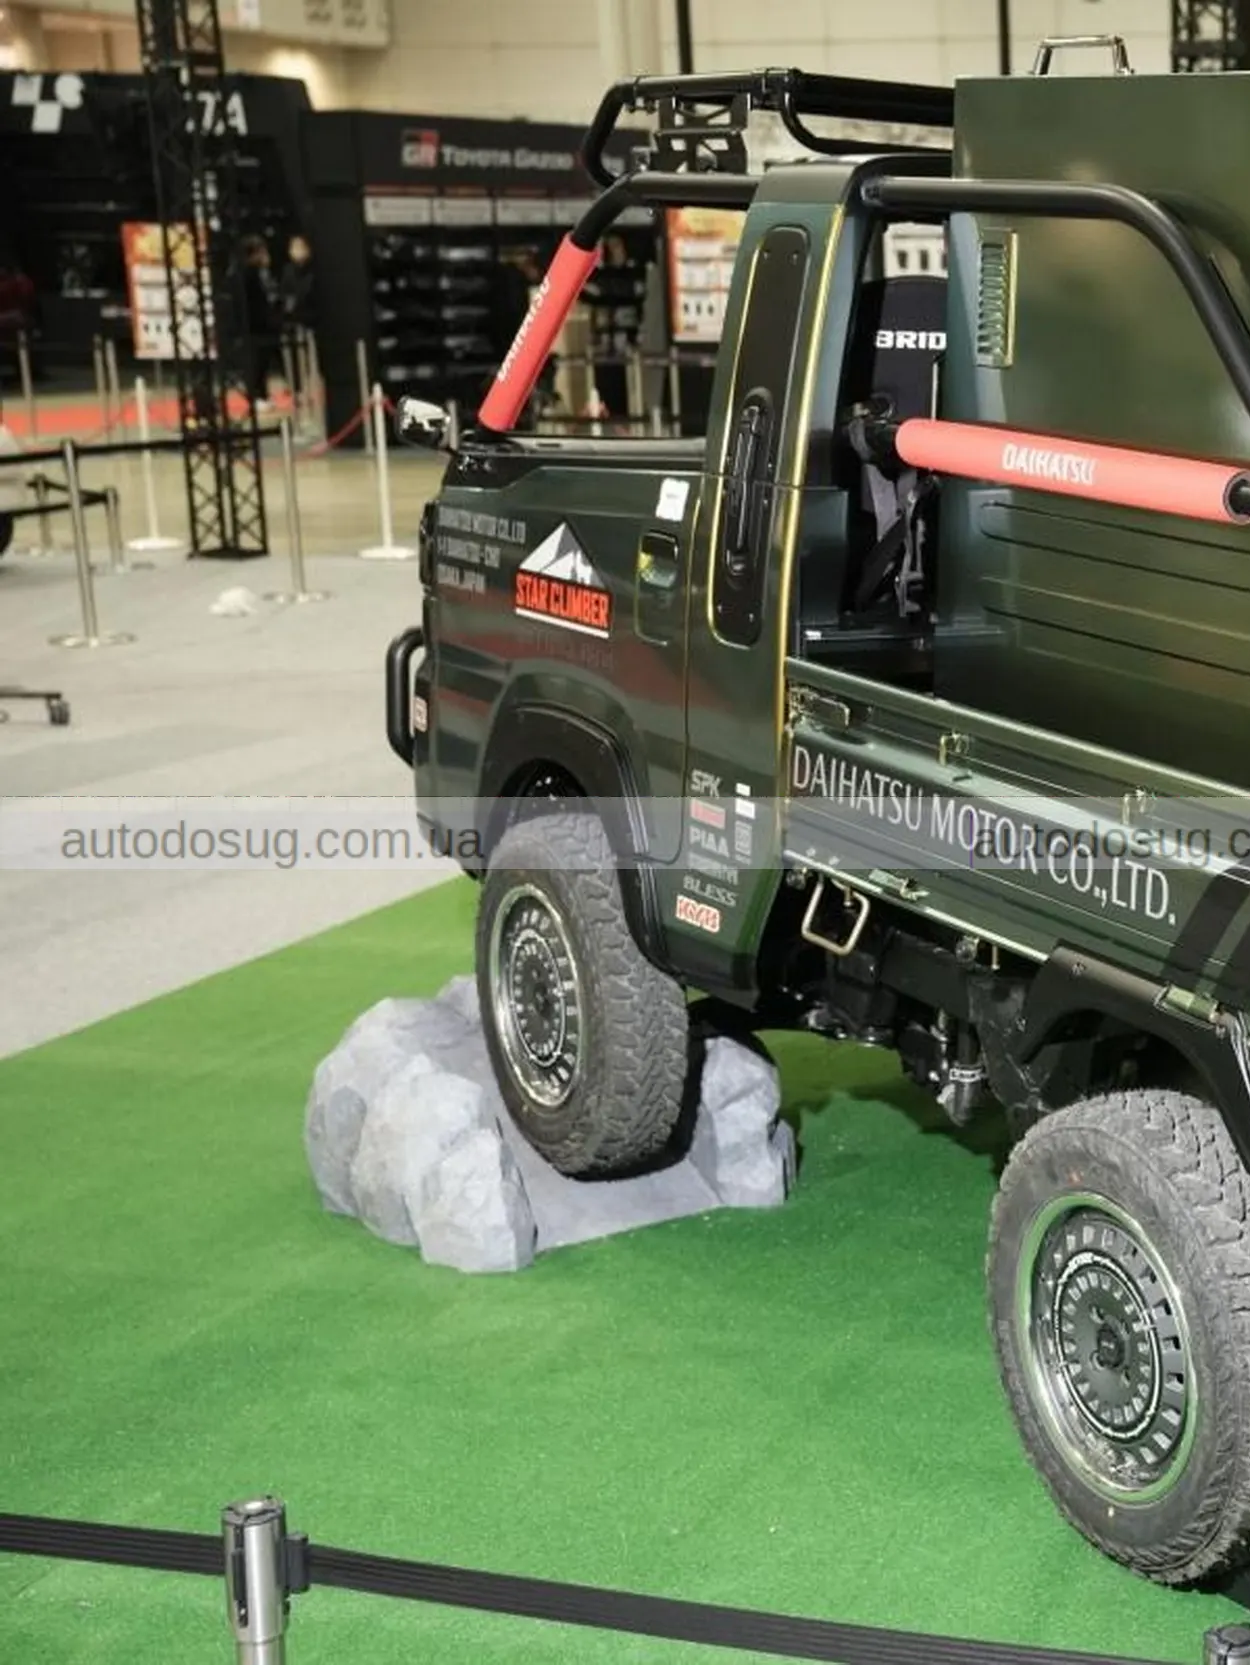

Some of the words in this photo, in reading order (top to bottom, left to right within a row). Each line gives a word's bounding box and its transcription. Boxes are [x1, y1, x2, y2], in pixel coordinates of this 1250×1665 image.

[1003, 443, 1097, 486] DAIHATSU
[516, 573, 549, 614] STAR
[551, 581, 609, 629] CLIMBER
[690, 769, 722, 798] SPK
[792, 745, 924, 831] DAIHATSU
[930, 794, 1040, 875] MOTOR
[689, 826, 730, 858] PIAA
[683, 875, 738, 907] BLESS
